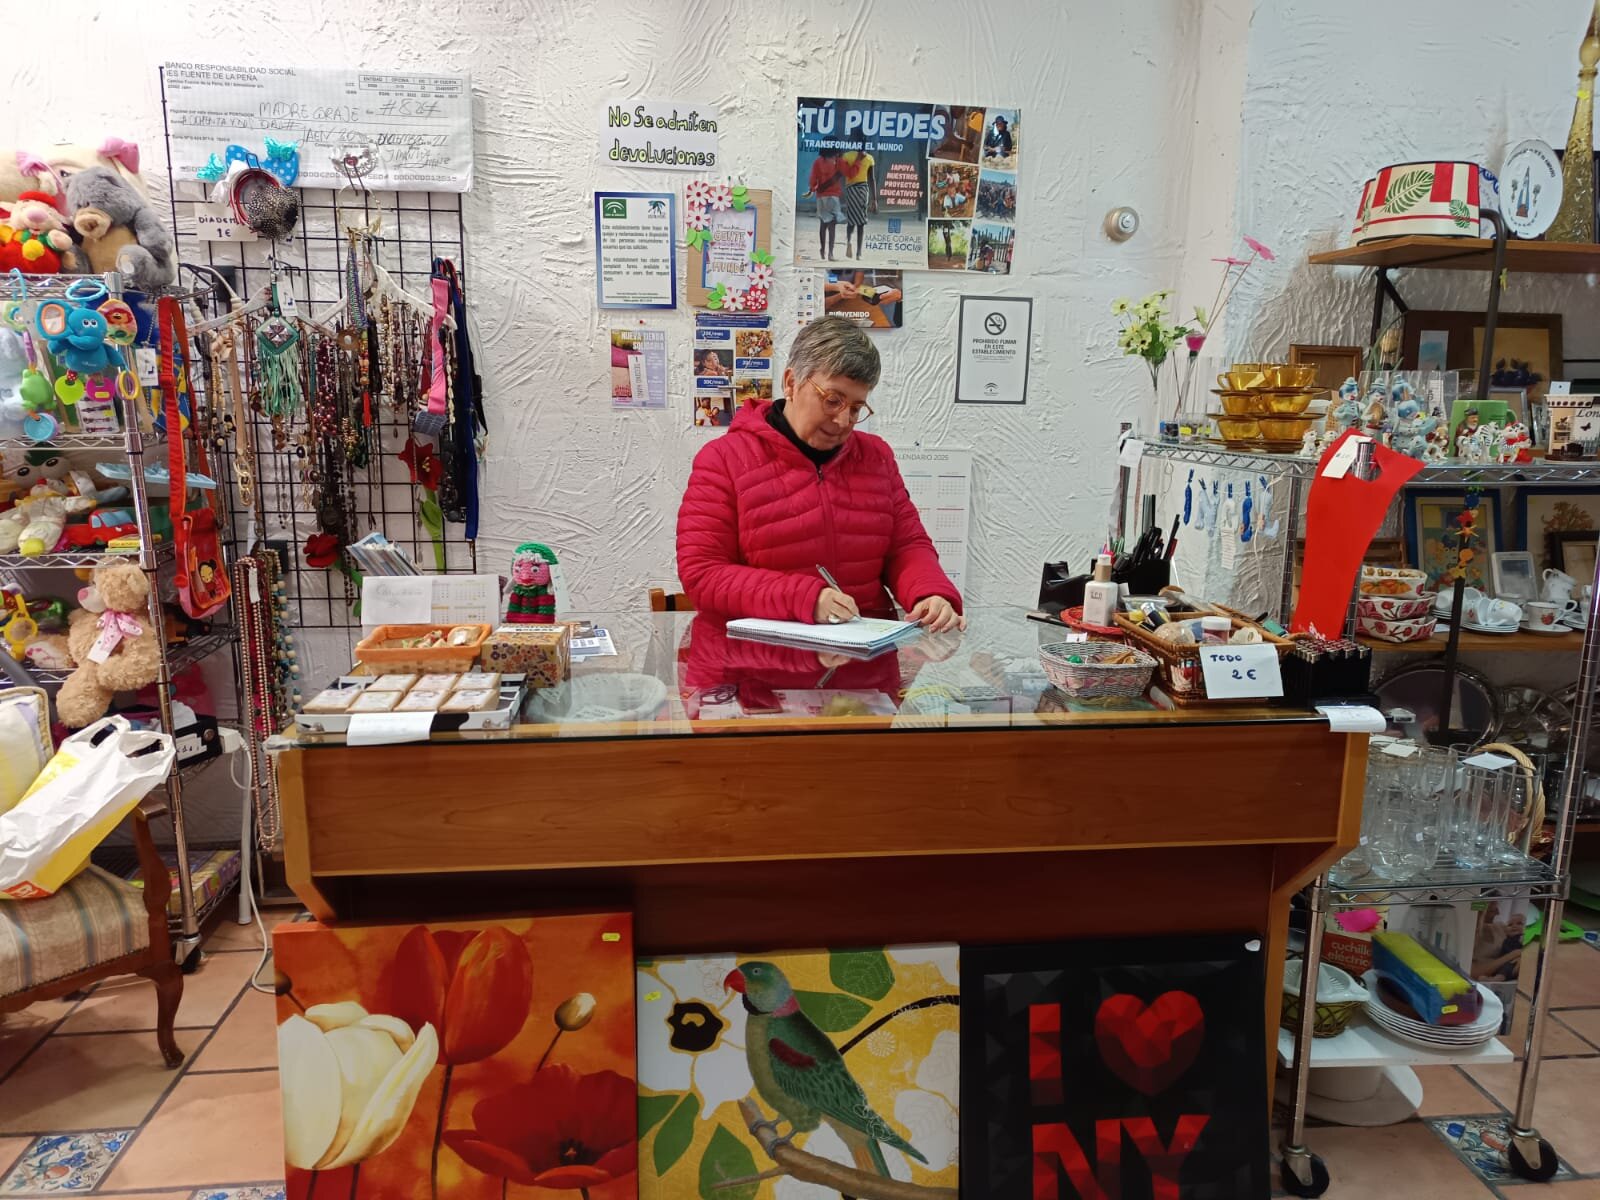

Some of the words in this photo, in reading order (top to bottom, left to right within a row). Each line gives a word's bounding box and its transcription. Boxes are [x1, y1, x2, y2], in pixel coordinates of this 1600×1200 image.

[165, 61, 193, 70] BANCO
[194, 63, 267, 74] RESPONSABILIDAD
[268, 68, 297, 77] SOCIAL
[180, 71, 212, 79] FUENTE
[608, 105, 631, 128] No
[633, 105, 653, 128] Se
[655, 109, 718, 133] admiten
[800, 101, 835, 135] TÚ
[844, 109, 946, 140] PUEDES
[804, 139, 863, 151] TRANSFORMAR
[864, 141, 875, 151] EL
[877, 142, 904, 152] MUNDO
[886, 172, 918, 180] NUESTROS
[884, 180, 920, 189] PROYECTOS
[879, 188, 918, 197] EDUCATIVOS
[886, 198, 896, 206] DE
[198, 215, 240, 224] DIADEM
[864, 234, 890, 242] MADRE
[892, 235, 922, 243] CORAJE
[864, 242, 892, 251] HAZTE
[1577, 407, 1600, 418] Lon
[1029, 1003, 1064, 1105] I
[1032, 1114, 1211, 1200] NY
